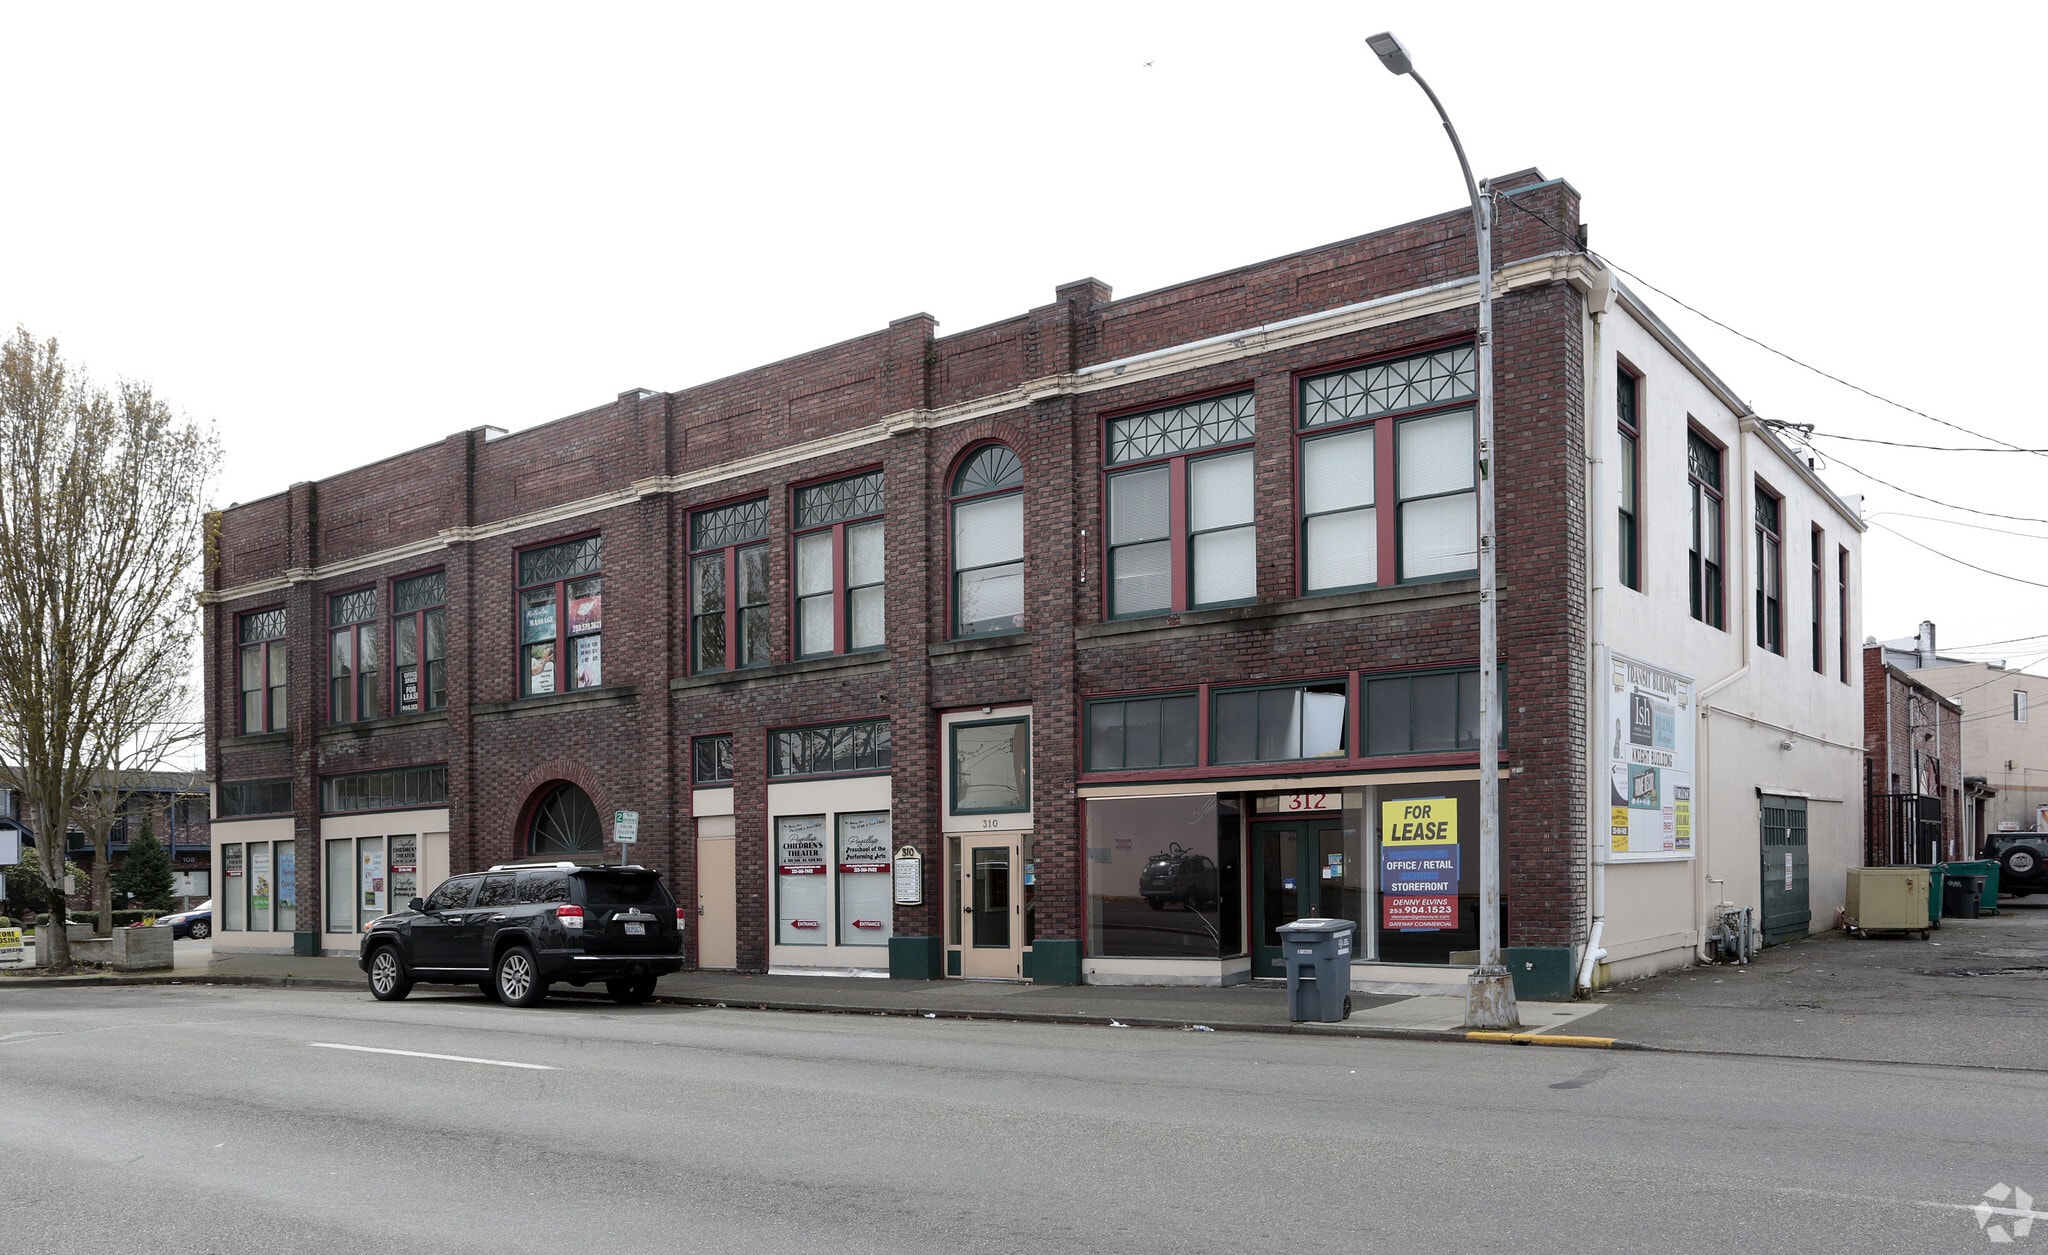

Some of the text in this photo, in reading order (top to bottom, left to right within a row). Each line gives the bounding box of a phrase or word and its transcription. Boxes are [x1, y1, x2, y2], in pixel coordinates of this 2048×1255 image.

[529, 616, 554, 627] MASSAGE
[1627, 665, 1677, 696] TRANSIT BUILDING
[406, 686, 417, 694] FOR
[1635, 697, 1651, 726] Ish
[1632, 748, 1673, 767] KNIGHT BUILDING
[1289, 792, 1327, 810] 312
[617, 813, 622, 821] 2
[1404, 805, 1431, 820] FOR
[983, 819, 998, 828] 310
[1391, 821, 1448, 841] LEASE
[783, 842, 823, 850] CHILDREN'S
[902, 848, 914, 857] 310
[1386, 861, 1417, 870] OFFICE
[1423, 860, 1454, 869] RETAIL
[1391, 882, 1449, 891] STOREFRONT
[1421, 898, 1448, 906] ELVINS
[1389, 906, 1452, 914] 253.904.1523
